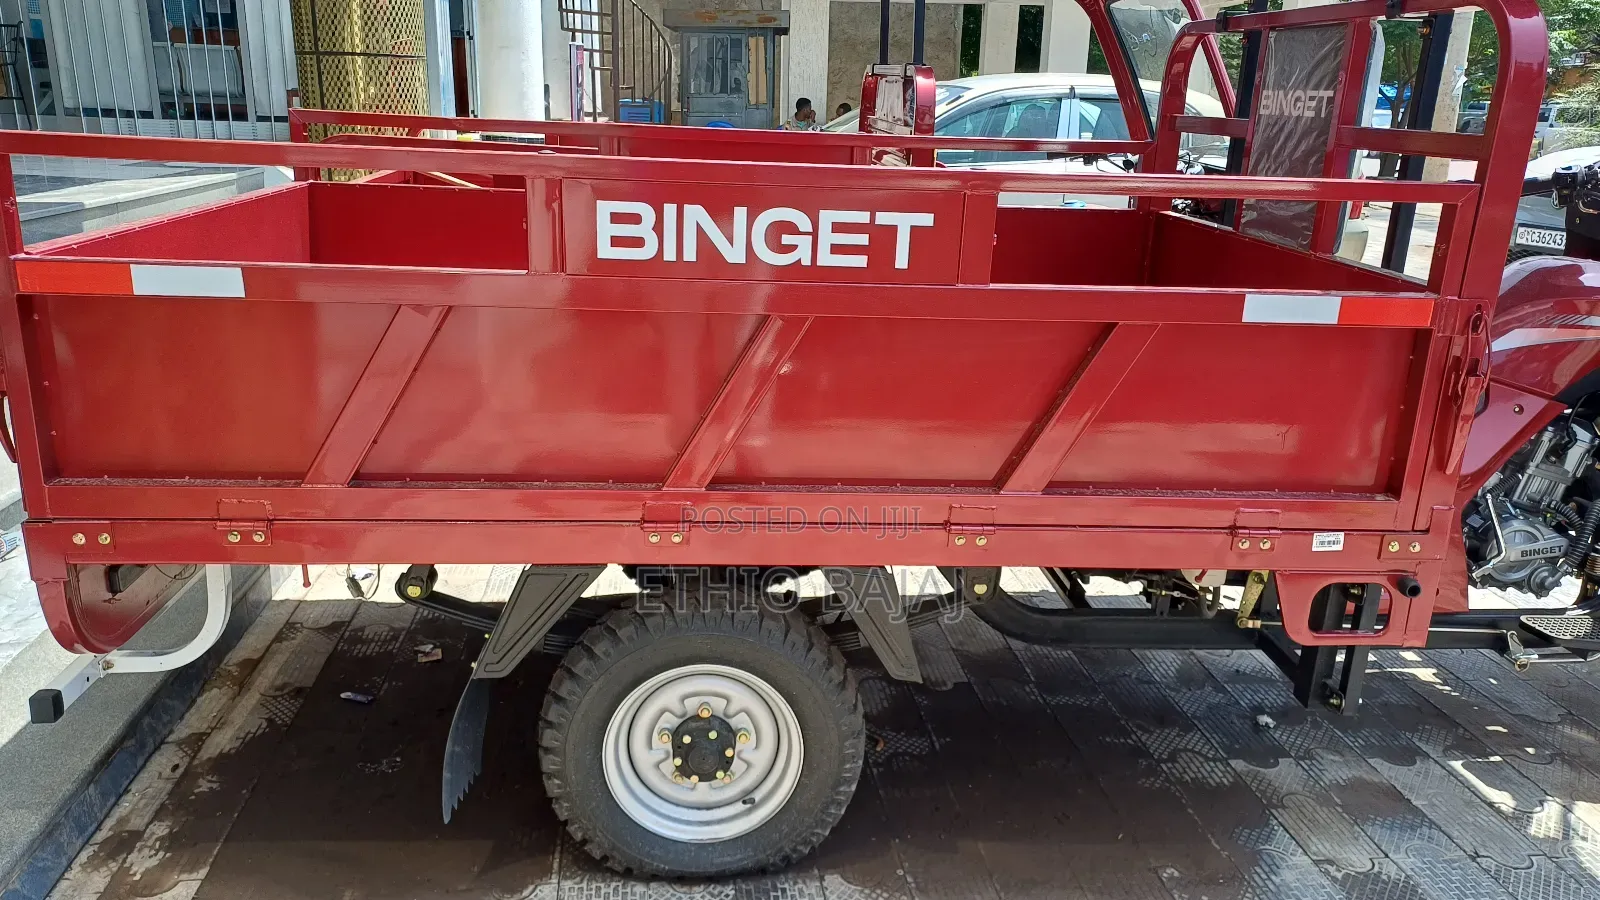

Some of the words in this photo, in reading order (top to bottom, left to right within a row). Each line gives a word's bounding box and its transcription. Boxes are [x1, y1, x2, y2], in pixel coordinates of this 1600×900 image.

[1260, 89, 1335, 118] BINGET
[596, 199, 935, 270] BINGET
[1520, 544, 1564, 558] BINGET
